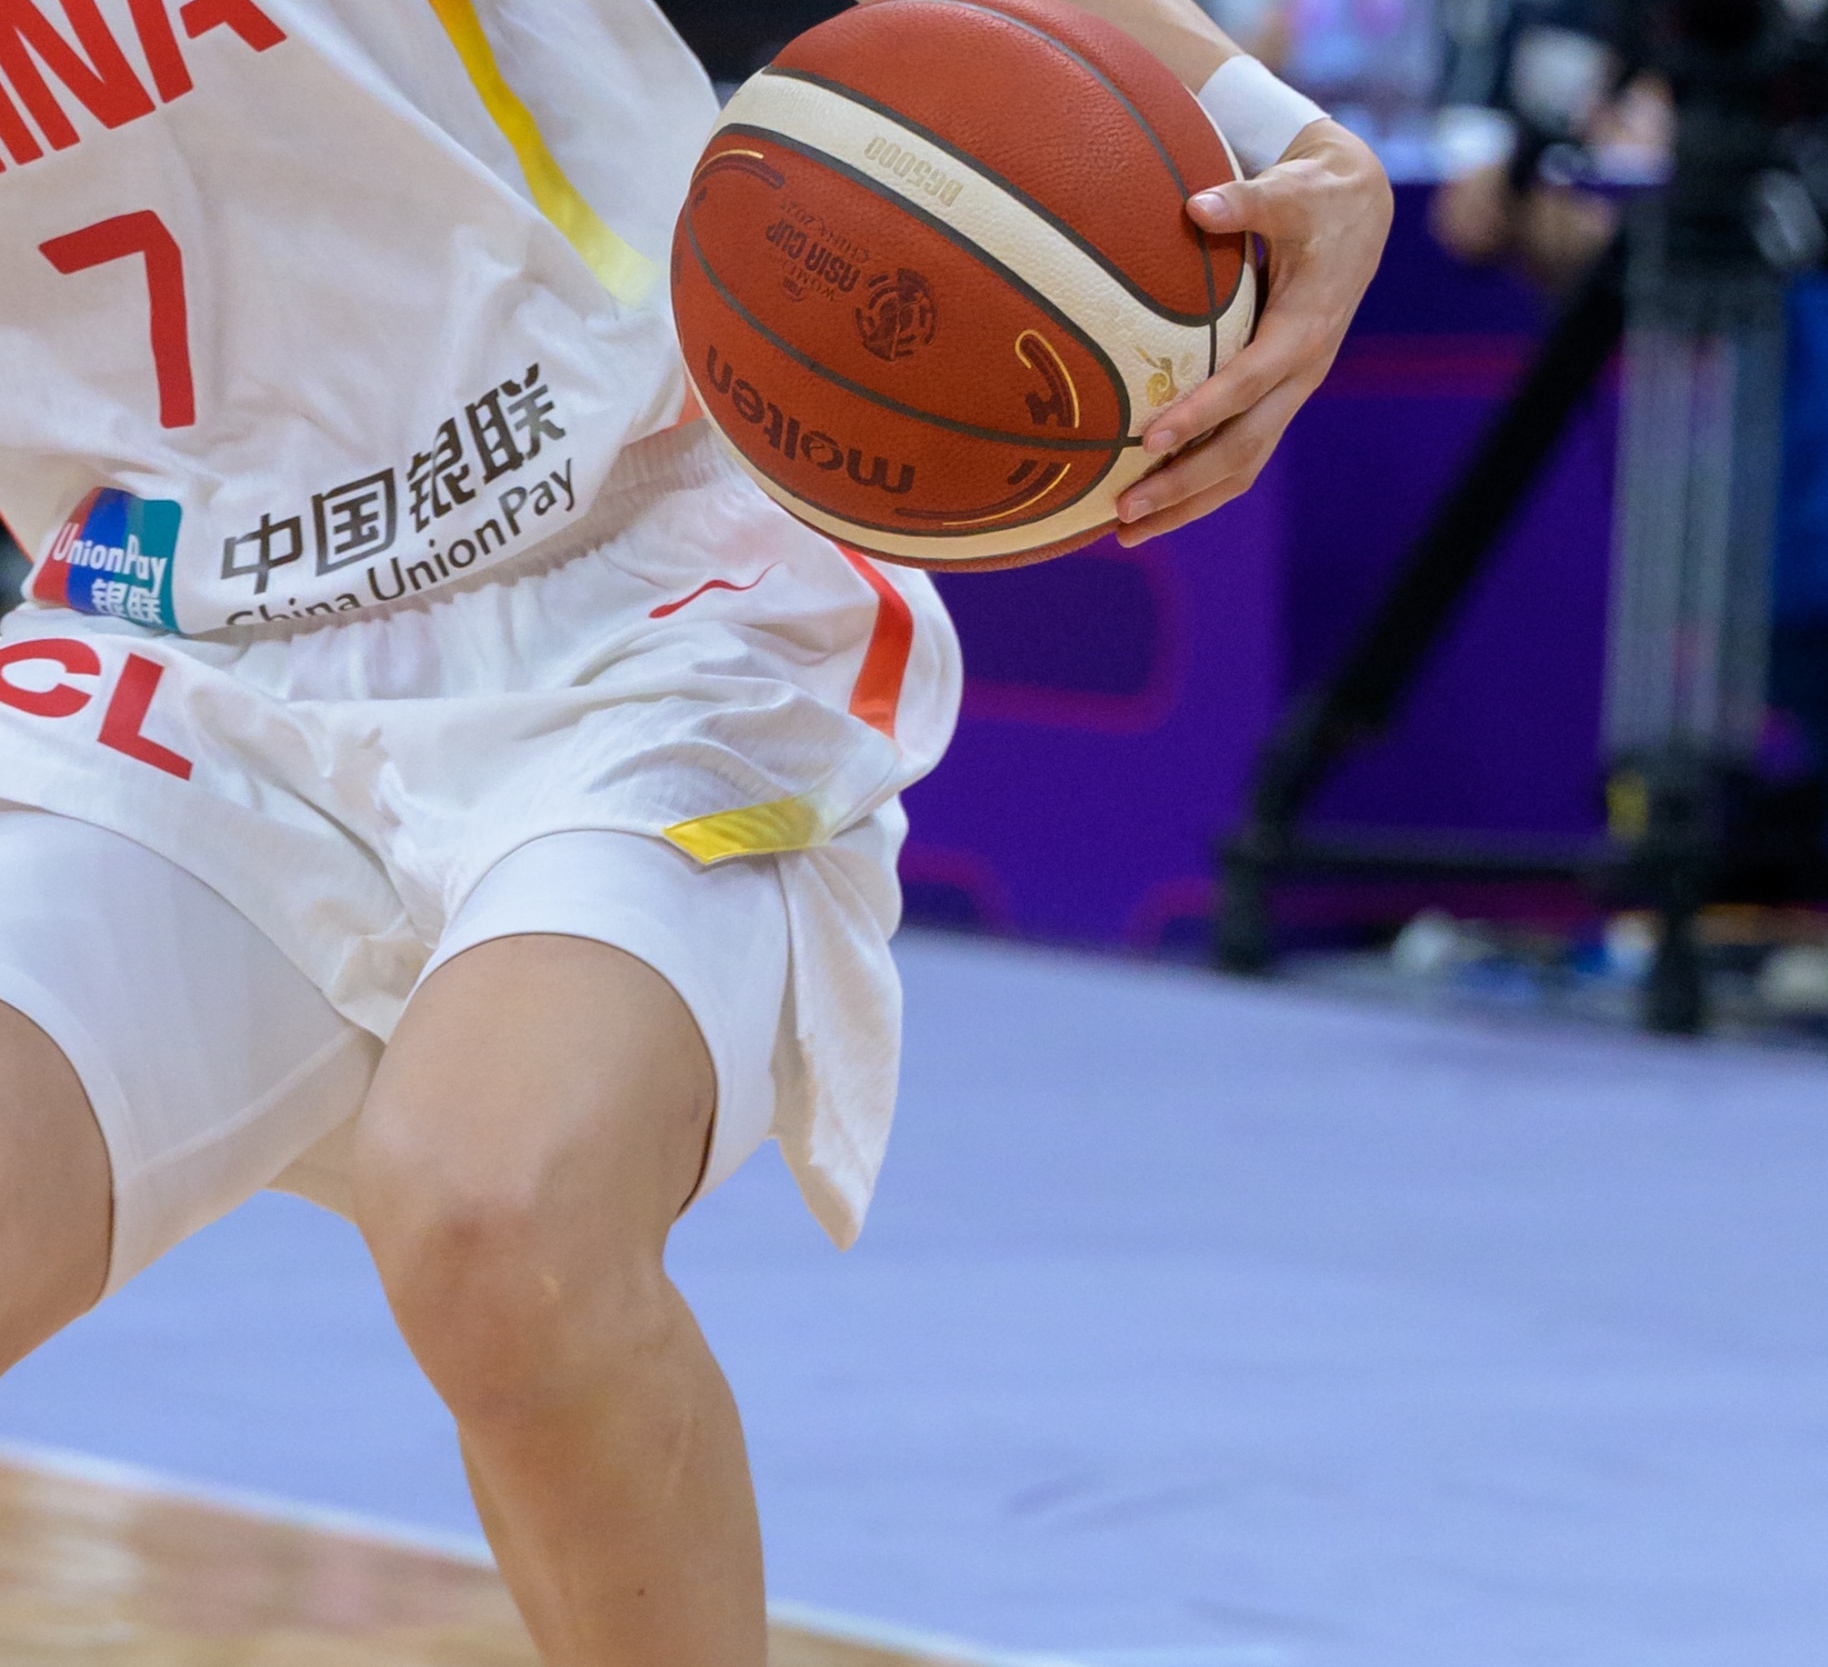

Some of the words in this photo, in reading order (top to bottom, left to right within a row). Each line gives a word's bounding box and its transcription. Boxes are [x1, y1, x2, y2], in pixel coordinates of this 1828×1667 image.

[864, 137, 964, 207] BG5000
[766, 218, 807, 259] CUP
[805, 242, 861, 292] ASIA
[38, 209, 196, 429] 7
[707, 344, 915, 494] molten
[220, 363, 566, 595] 中国银联
[53, 523, 168, 598] UnionPay
[367, 459, 574, 601] UnionPay
[91, 579, 163, 624] 银联
